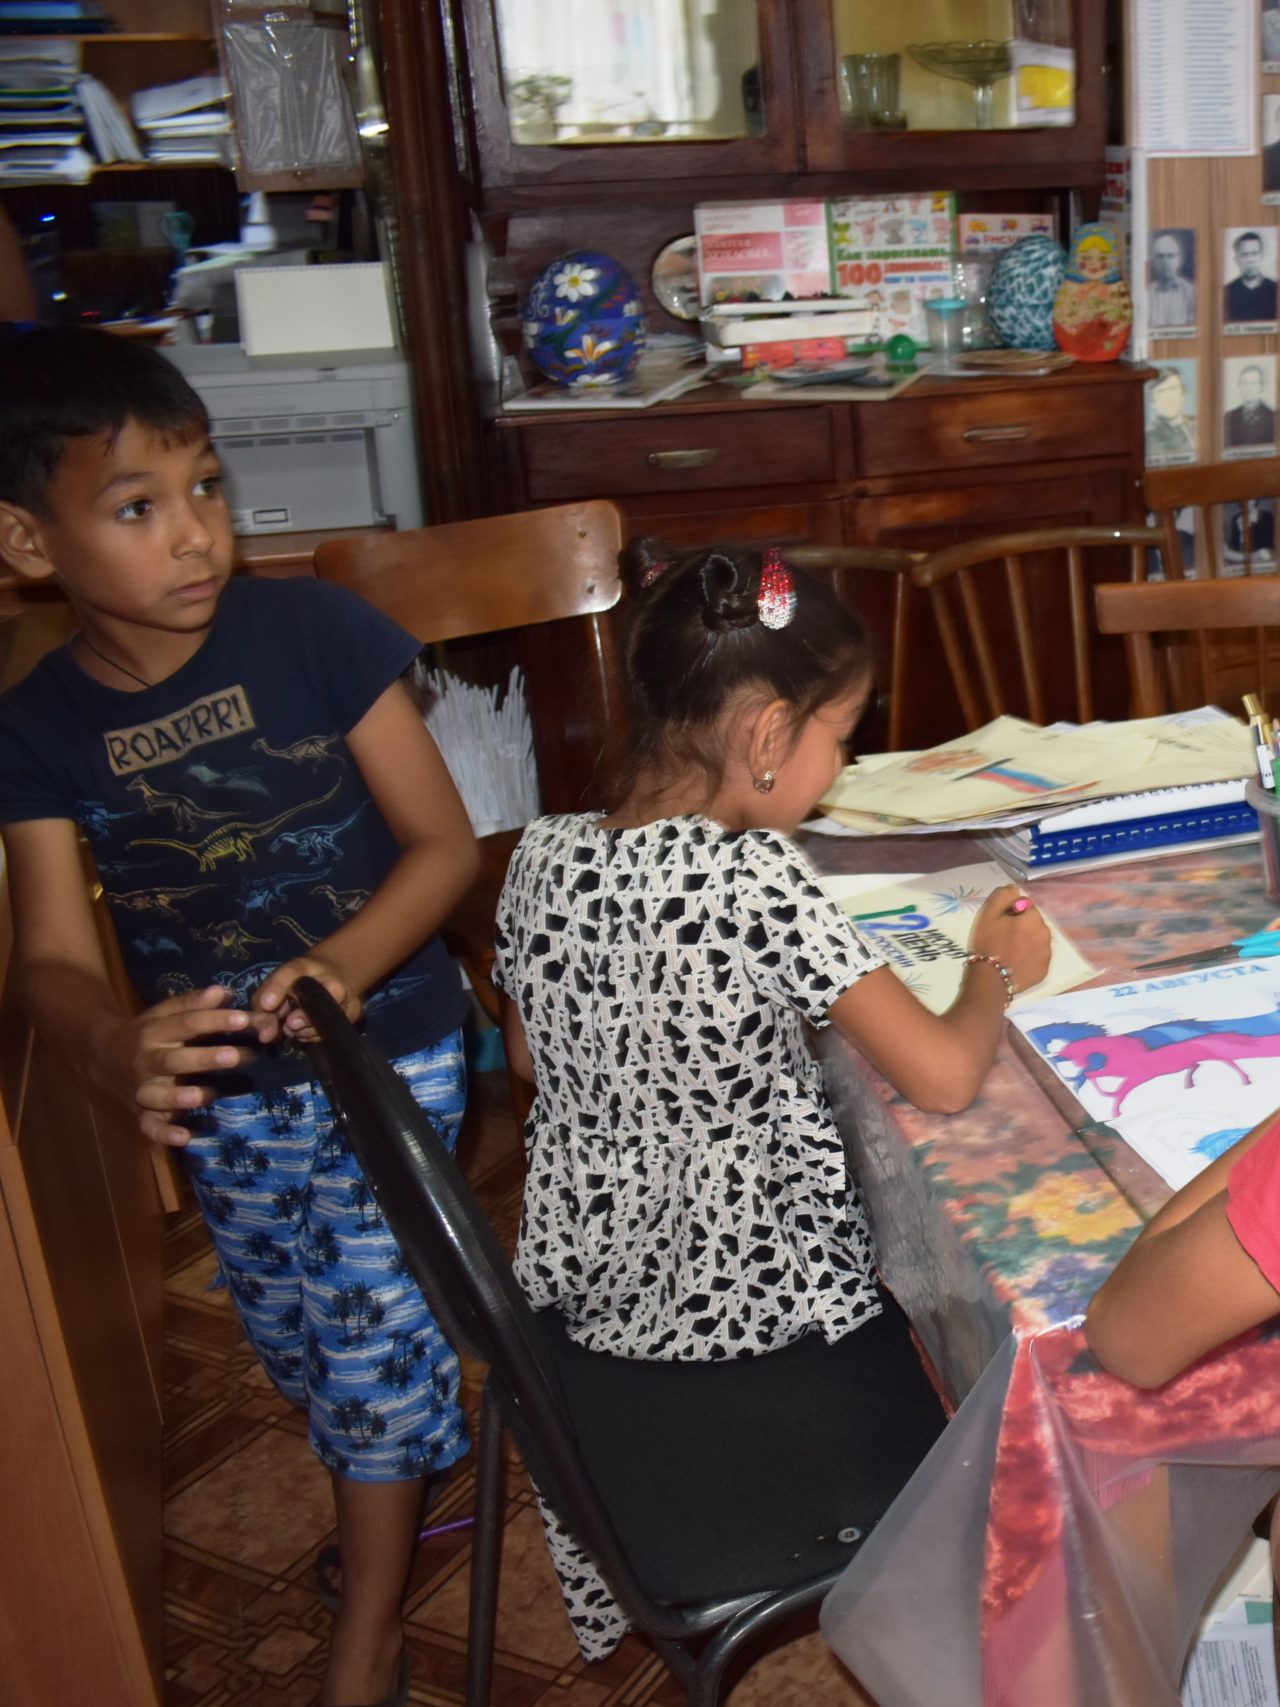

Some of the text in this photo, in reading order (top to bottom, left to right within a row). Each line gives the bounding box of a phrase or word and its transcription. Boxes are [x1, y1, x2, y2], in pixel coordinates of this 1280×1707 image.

[836, 260, 882, 288] 100
[108, 693, 247, 770] ROARRR!
[1110, 986, 1138, 999] 22
[1145, 963, 1270, 994] АВГУСТА
